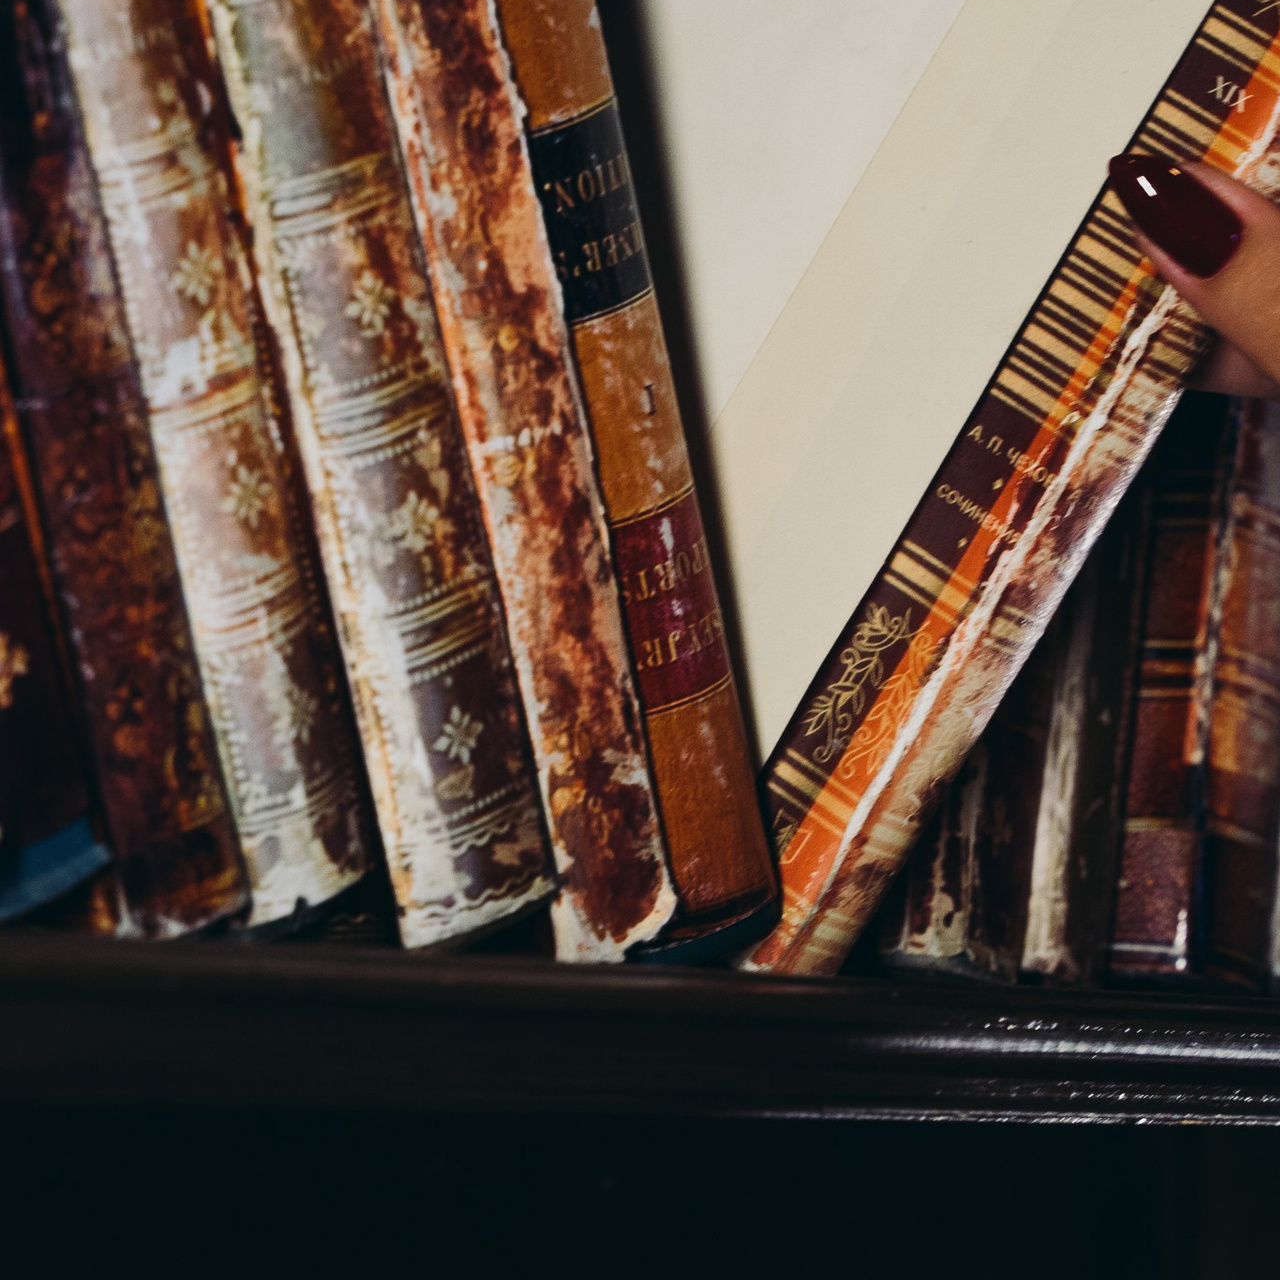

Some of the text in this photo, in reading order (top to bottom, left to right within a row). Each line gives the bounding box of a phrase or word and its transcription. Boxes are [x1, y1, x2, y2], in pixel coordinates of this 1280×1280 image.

[1206, 74, 1254, 113] XIX
[966, 424, 984, 445] А.
[985, 435, 1003, 457] П.
